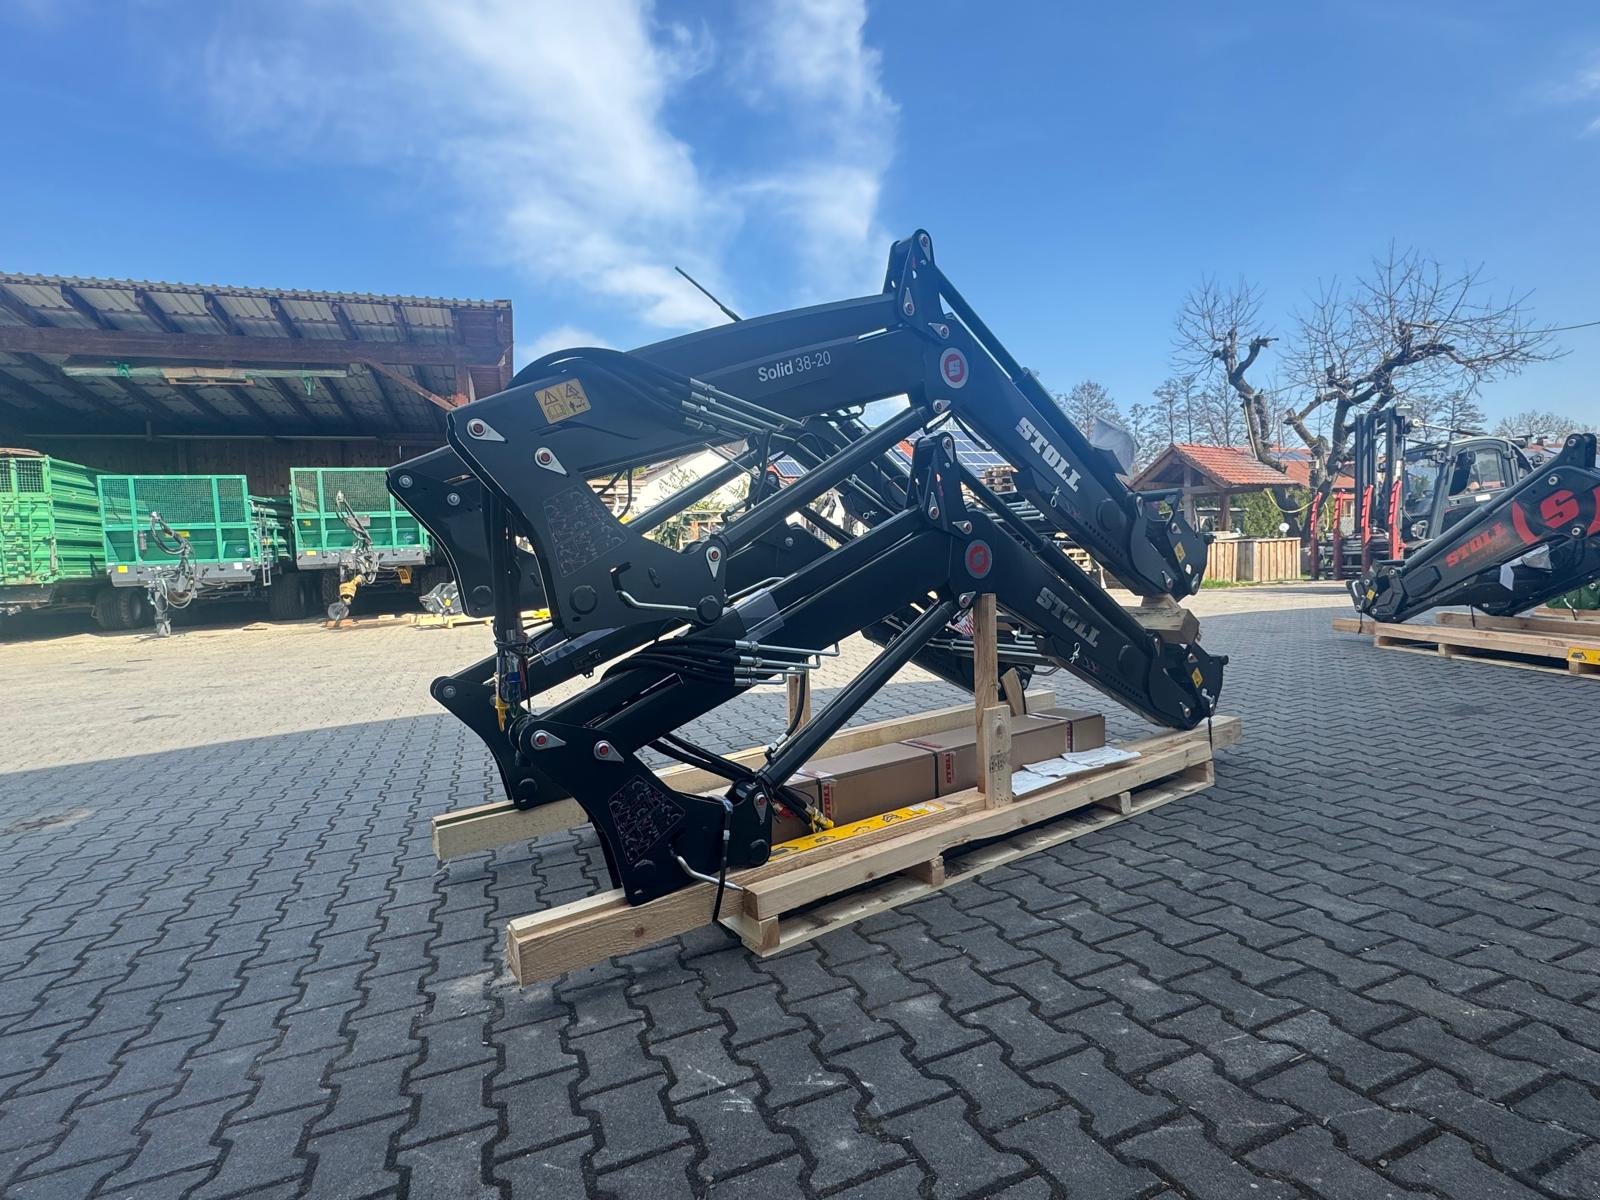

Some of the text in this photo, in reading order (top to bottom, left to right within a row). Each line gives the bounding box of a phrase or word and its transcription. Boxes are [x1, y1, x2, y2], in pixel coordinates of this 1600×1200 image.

[758, 351, 831, 382] Solid 38-20
[1015, 416, 1082, 493] STOLL
[1445, 522, 1504, 567] STOLL
[1036, 586, 1100, 648] STOLL
